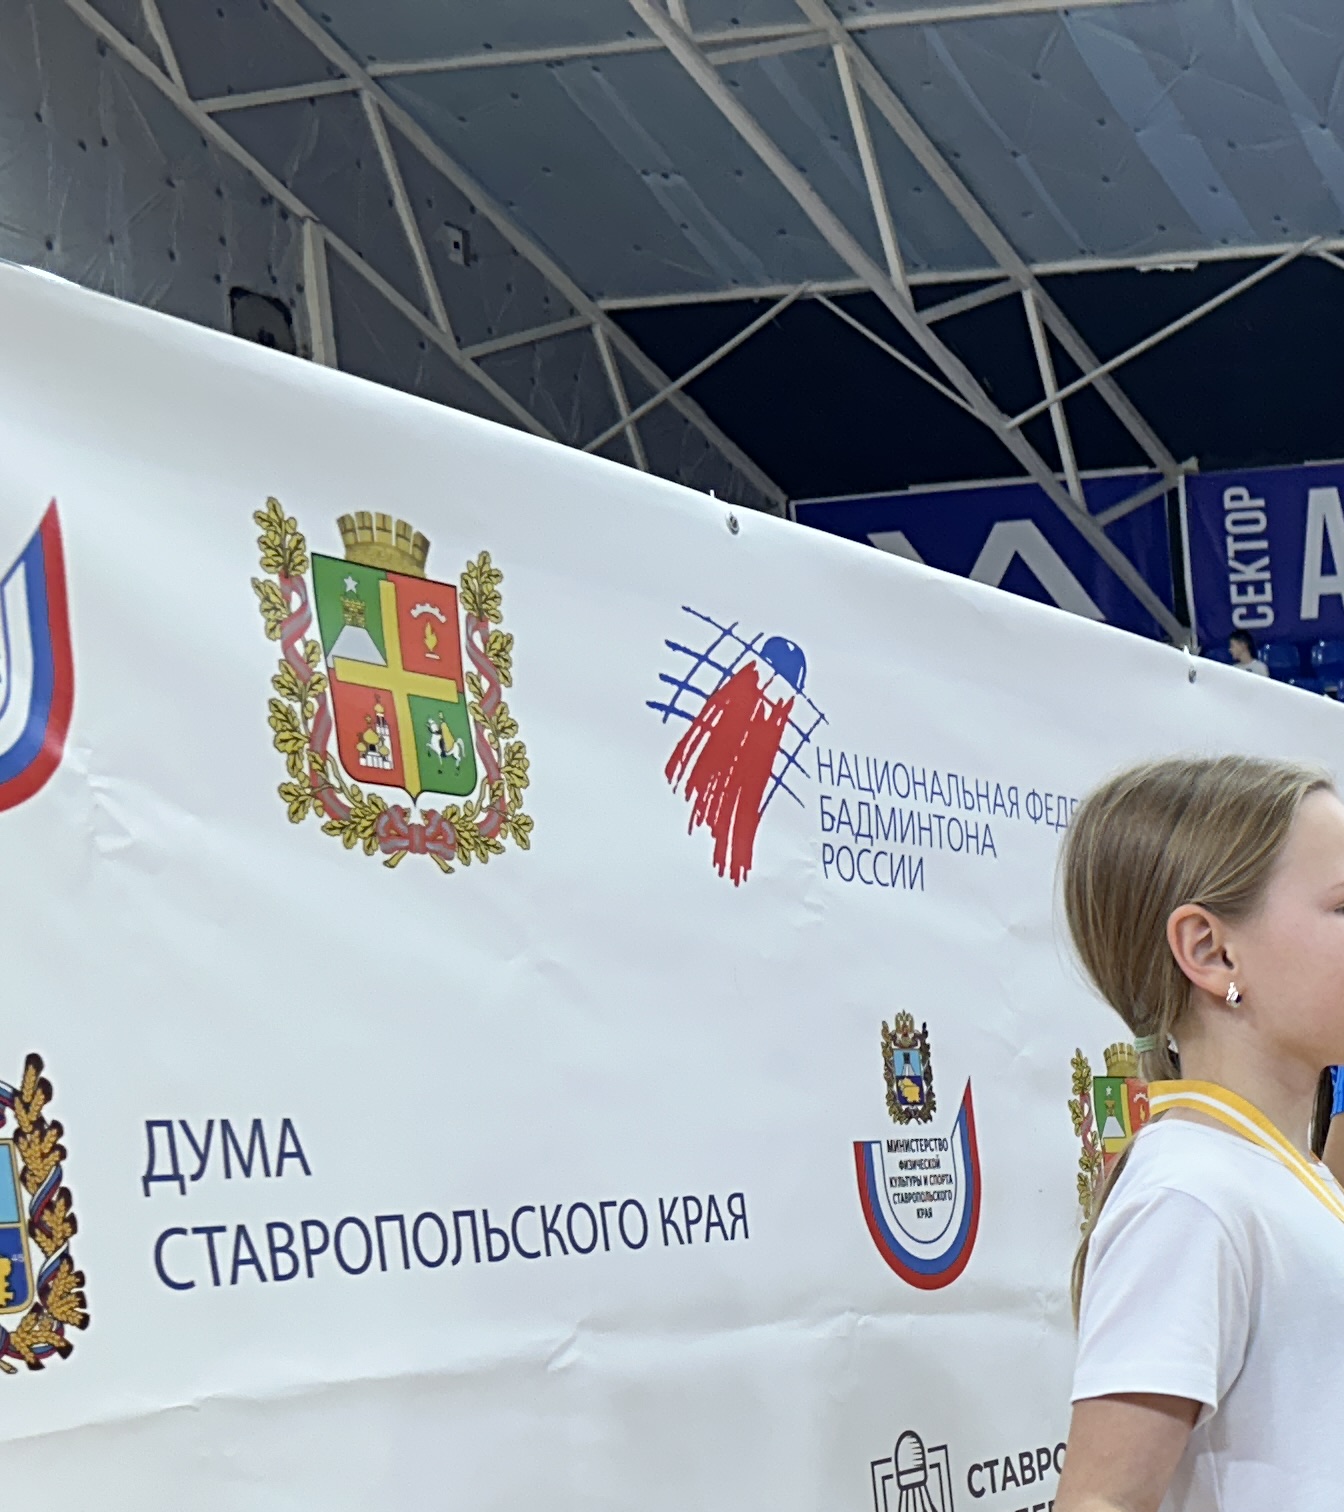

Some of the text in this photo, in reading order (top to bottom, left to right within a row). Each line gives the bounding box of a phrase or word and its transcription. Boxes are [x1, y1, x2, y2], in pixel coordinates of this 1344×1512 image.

[1223, 485, 1275, 630] СЕКТОР
[816, 746, 1020, 820] НАЦИОНАЛЬНАЯ
[819, 794, 998, 859] БАДМИНТОНА
[822, 842, 925, 892] РОССИИ
[141, 1117, 312, 1196] ДУМА
[886, 1138, 948, 1153] МИНИСТЕРСТВО
[153, 1191, 751, 1291] СТАВРОПОЛЬСКОГО КРАЯ
